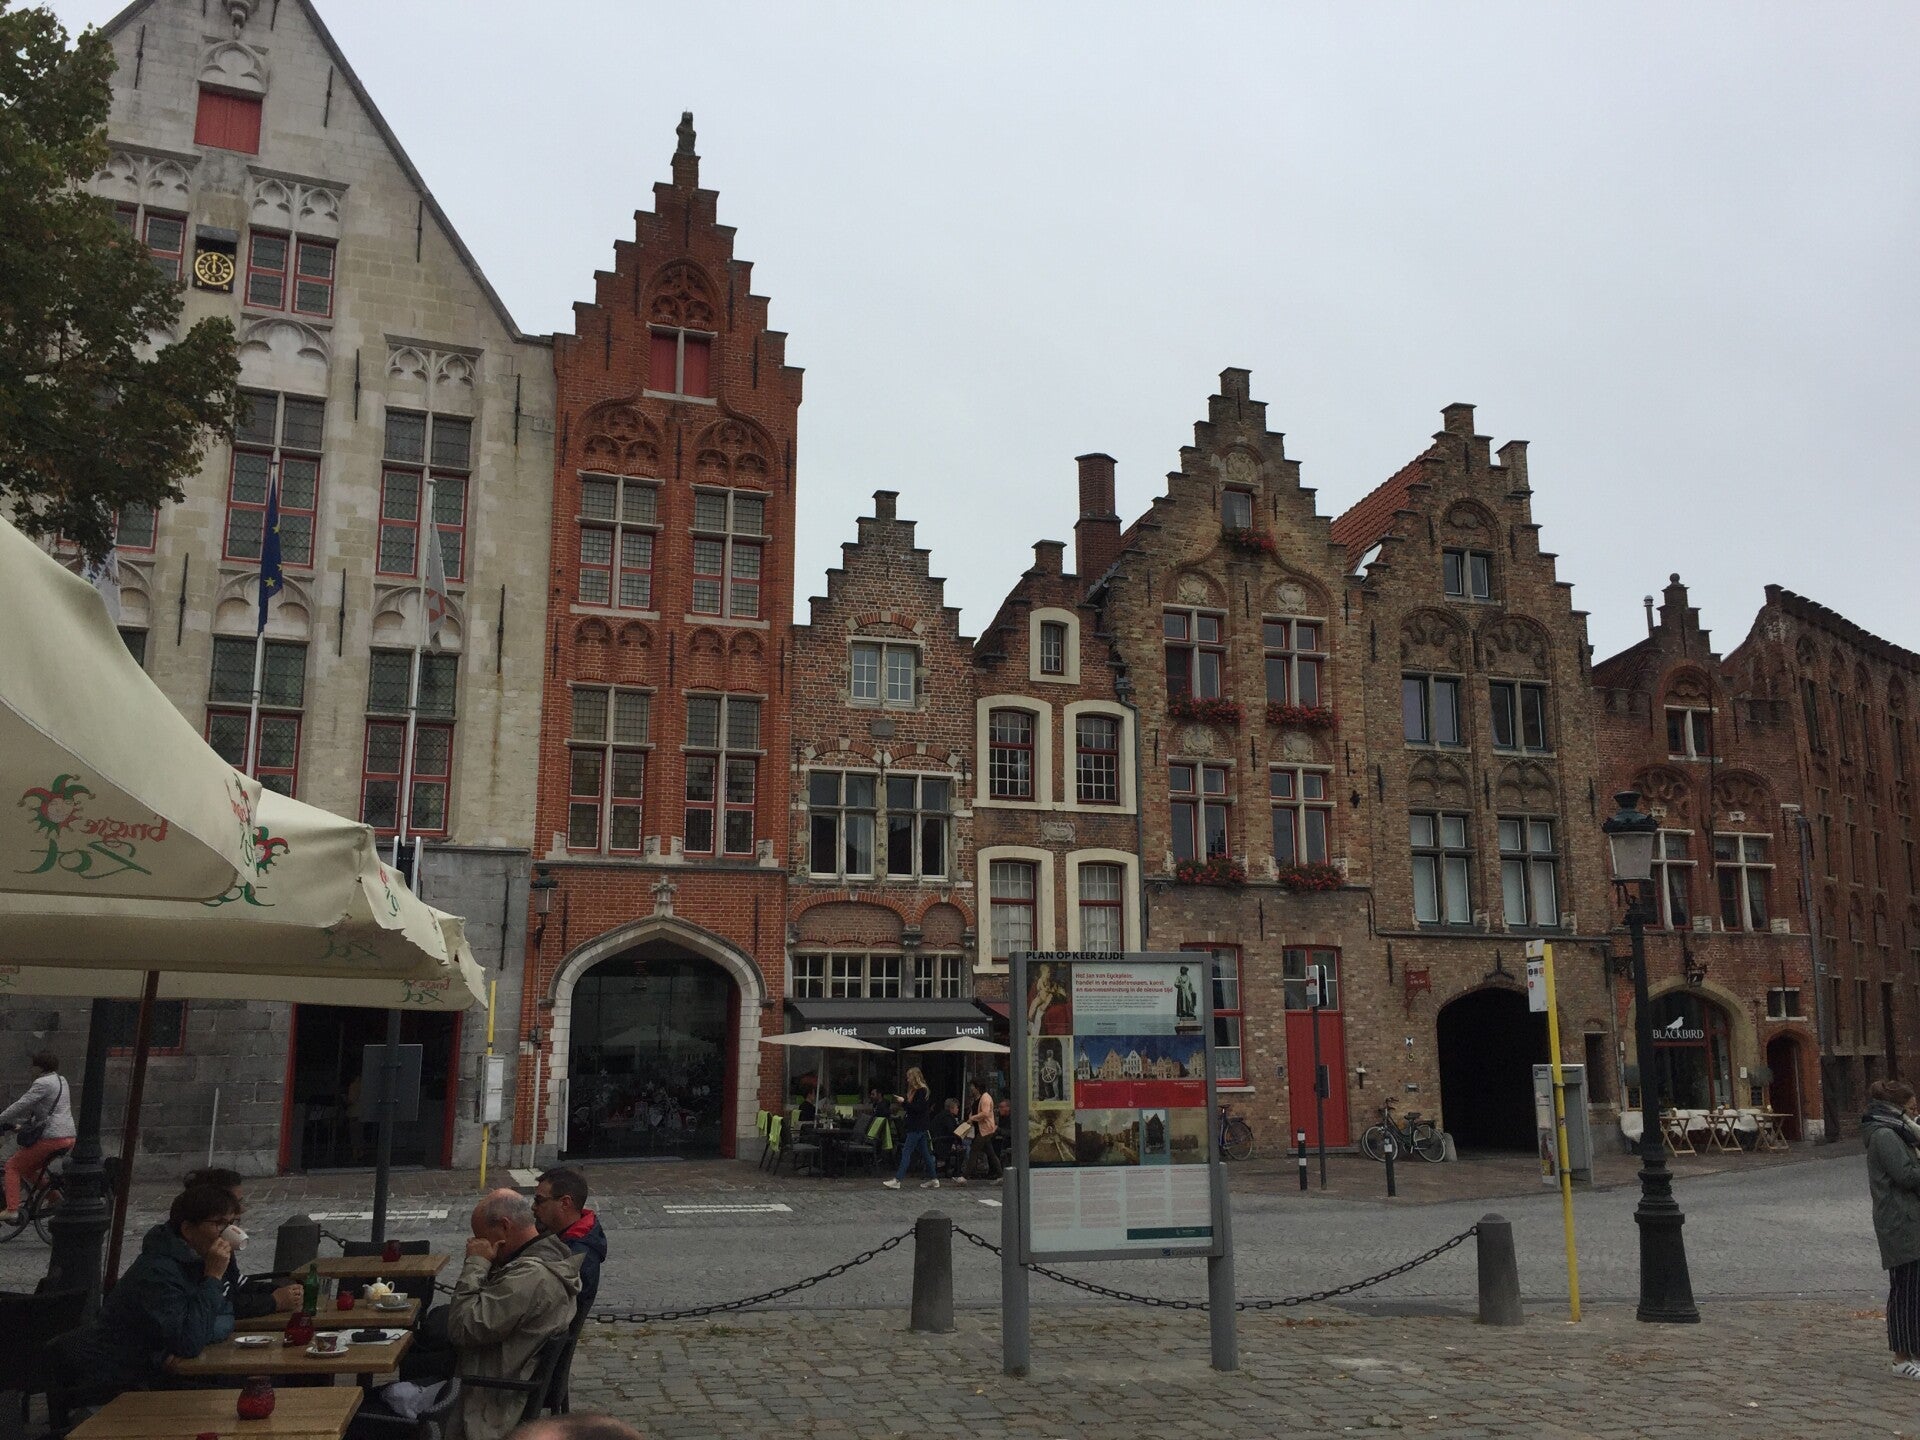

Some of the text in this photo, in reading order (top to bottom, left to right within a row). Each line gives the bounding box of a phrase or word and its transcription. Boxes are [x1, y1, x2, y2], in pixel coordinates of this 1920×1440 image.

[1025, 951, 1054, 960] PLAN
[811, 1026, 984, 1036] Bakfast @Tatties Lunch
[1652, 1029, 1705, 1039] BLACKBIRD
